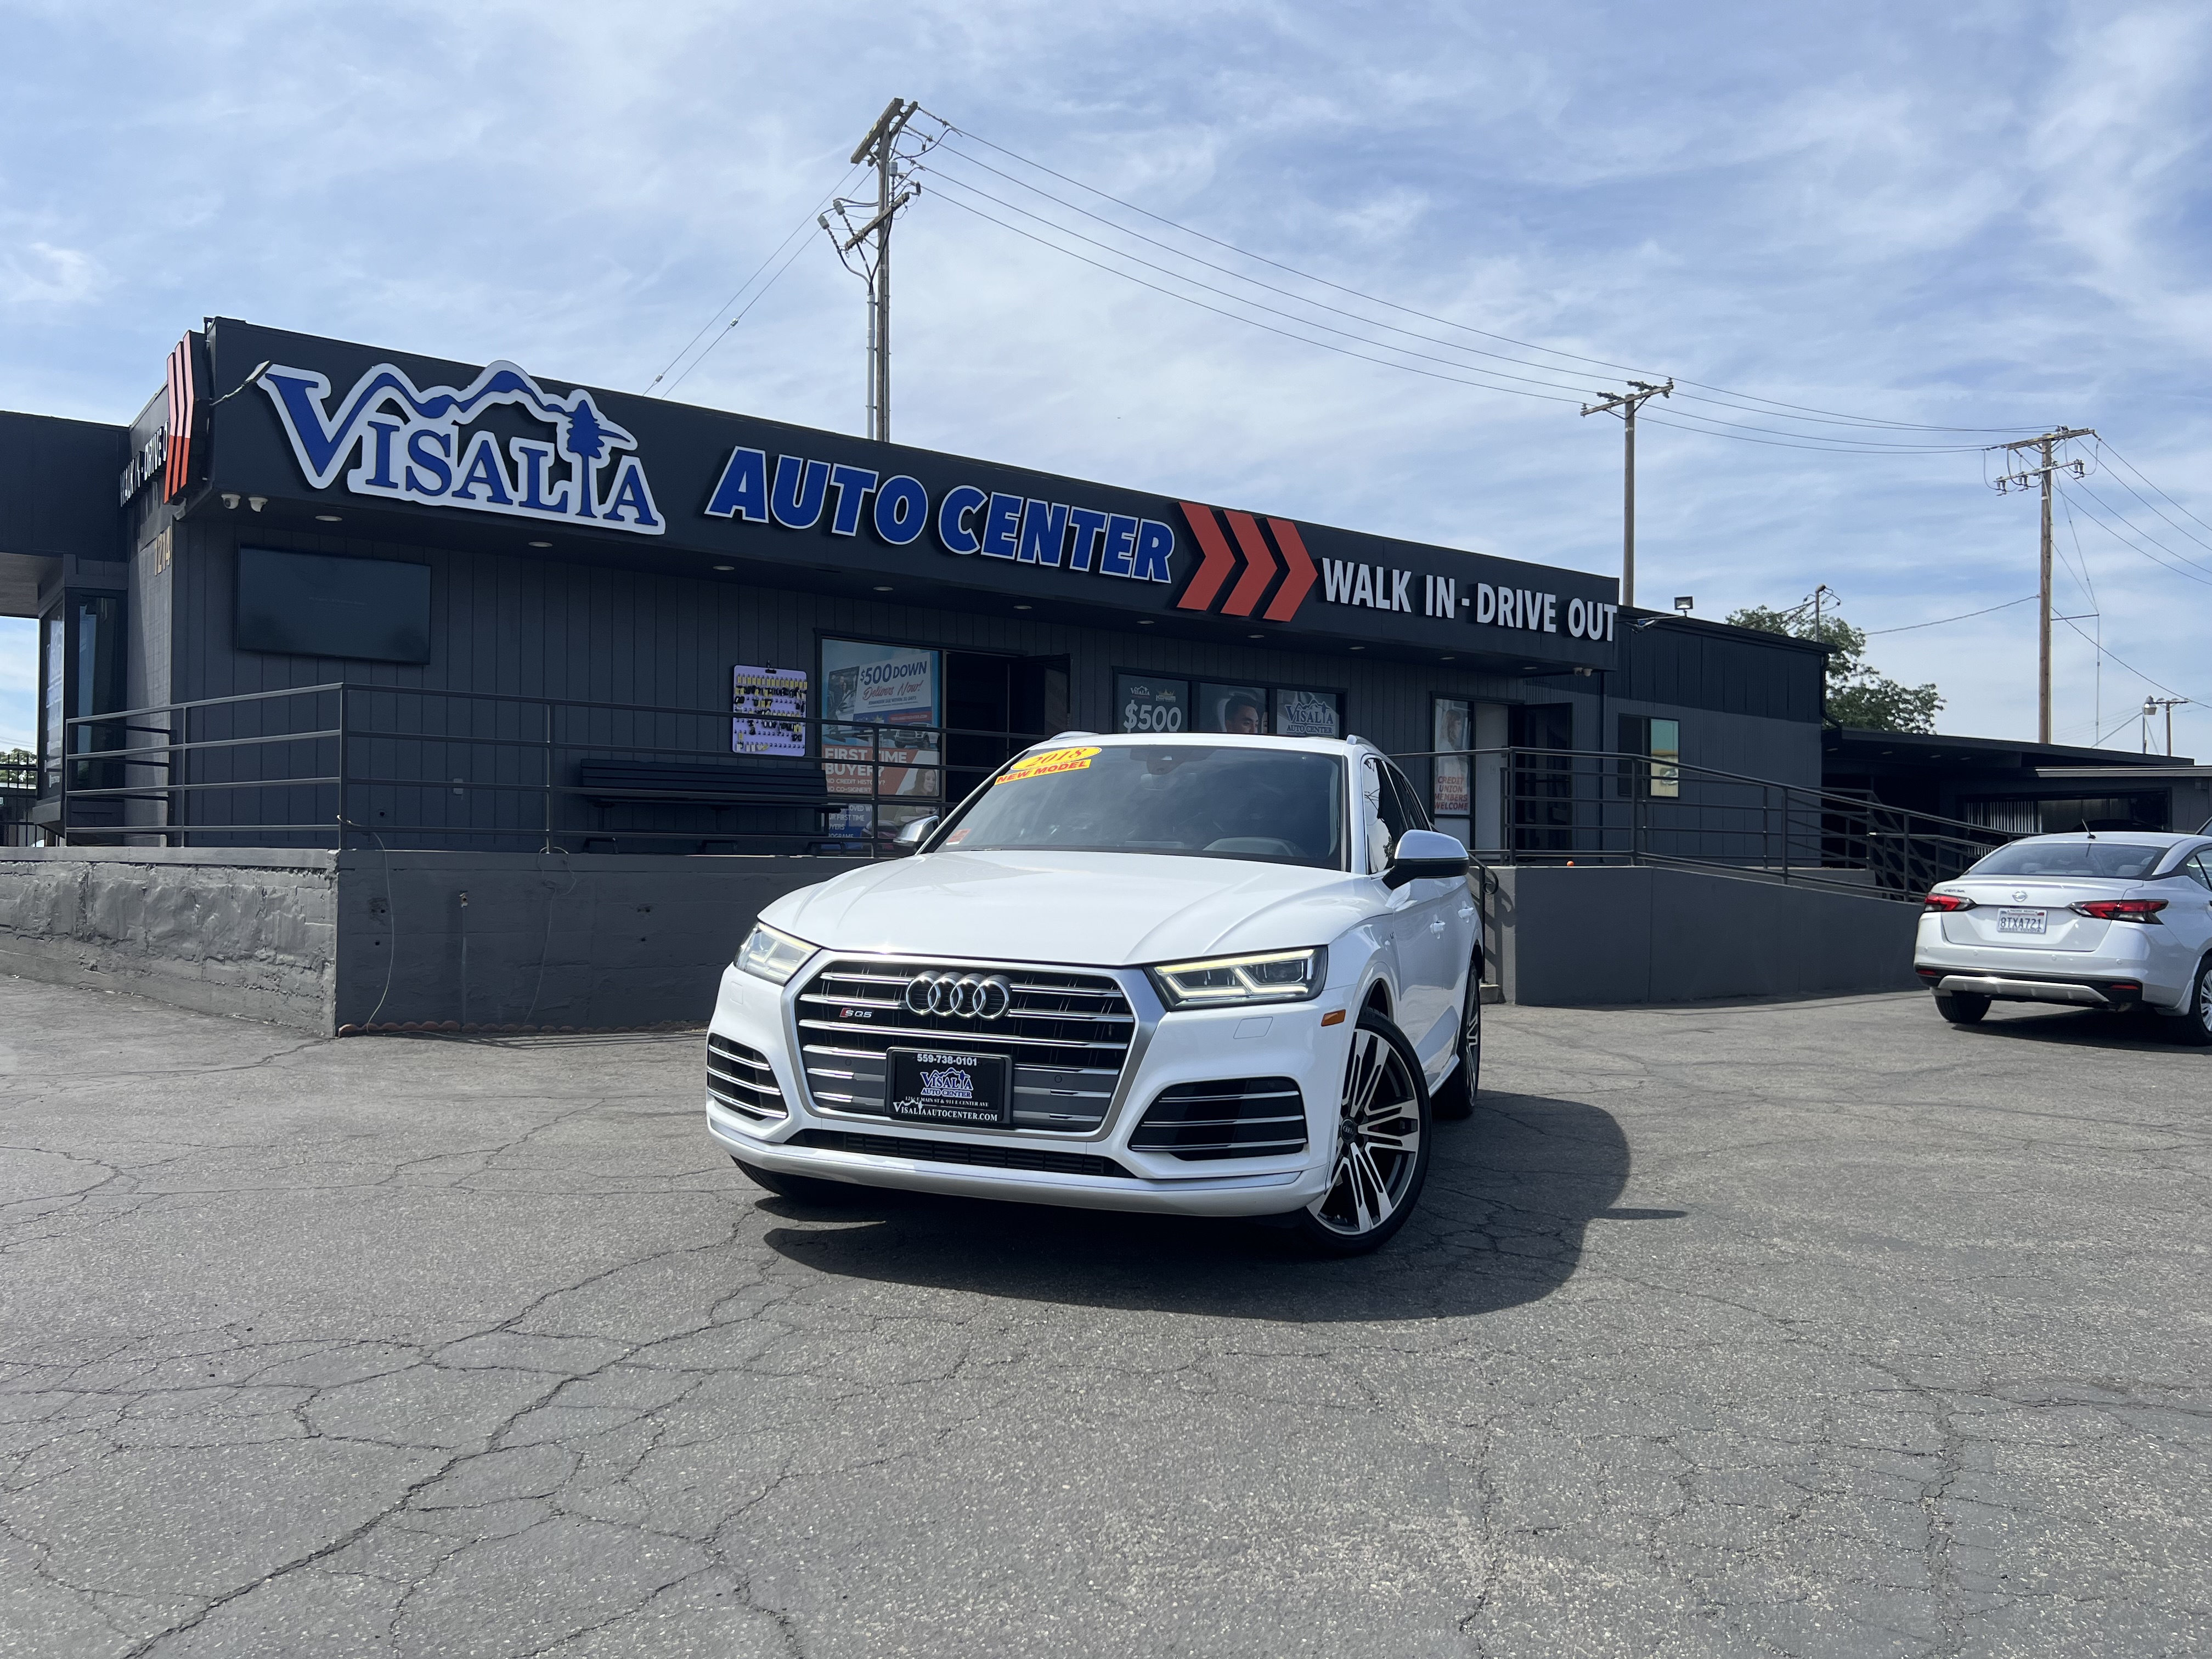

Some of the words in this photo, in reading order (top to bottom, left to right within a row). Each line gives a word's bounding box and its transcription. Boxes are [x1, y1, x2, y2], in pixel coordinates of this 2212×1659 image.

[258, 361, 666, 534] VISALIA
[120, 458, 134, 507] WALK
[144, 427, 162, 481] DRIVE
[704, 446, 929, 545] AUTO
[938, 485, 1175, 584] CENTER
[155, 526, 171, 576] 1214
[1322, 557, 1412, 613] WALK
[1568, 598, 1617, 642] OUT
[860, 664, 892, 685] $500
[893, 661, 927, 679] DOWN
[1124, 699, 1182, 733] $500
[1285, 698, 1334, 725] VISALIA
[1286, 724, 1305, 732] AUTO
[1306, 725, 1333, 734] CENTER
[825, 748, 868, 761] FIRST
[1026, 748, 1087, 768] 2018
[996, 770, 1031, 784] NEW
[1034, 760, 1086, 775] MODEL
[1437, 776, 1464, 785] CREDIT
[1435, 793, 1468, 802] MEMBERS
[1439, 785, 1463, 793] UNION
[1435, 802, 1469, 810] WELCOME
[2000, 917, 2041, 929] 8TXA721
[844, 1009, 872, 1018] SQ5
[917, 1053, 977, 1066] 559-738-0101
[920, 1067, 973, 1091] VISALIA
[921, 1087, 941, 1096] AUTO
[942, 1089, 973, 1098] CENTER
